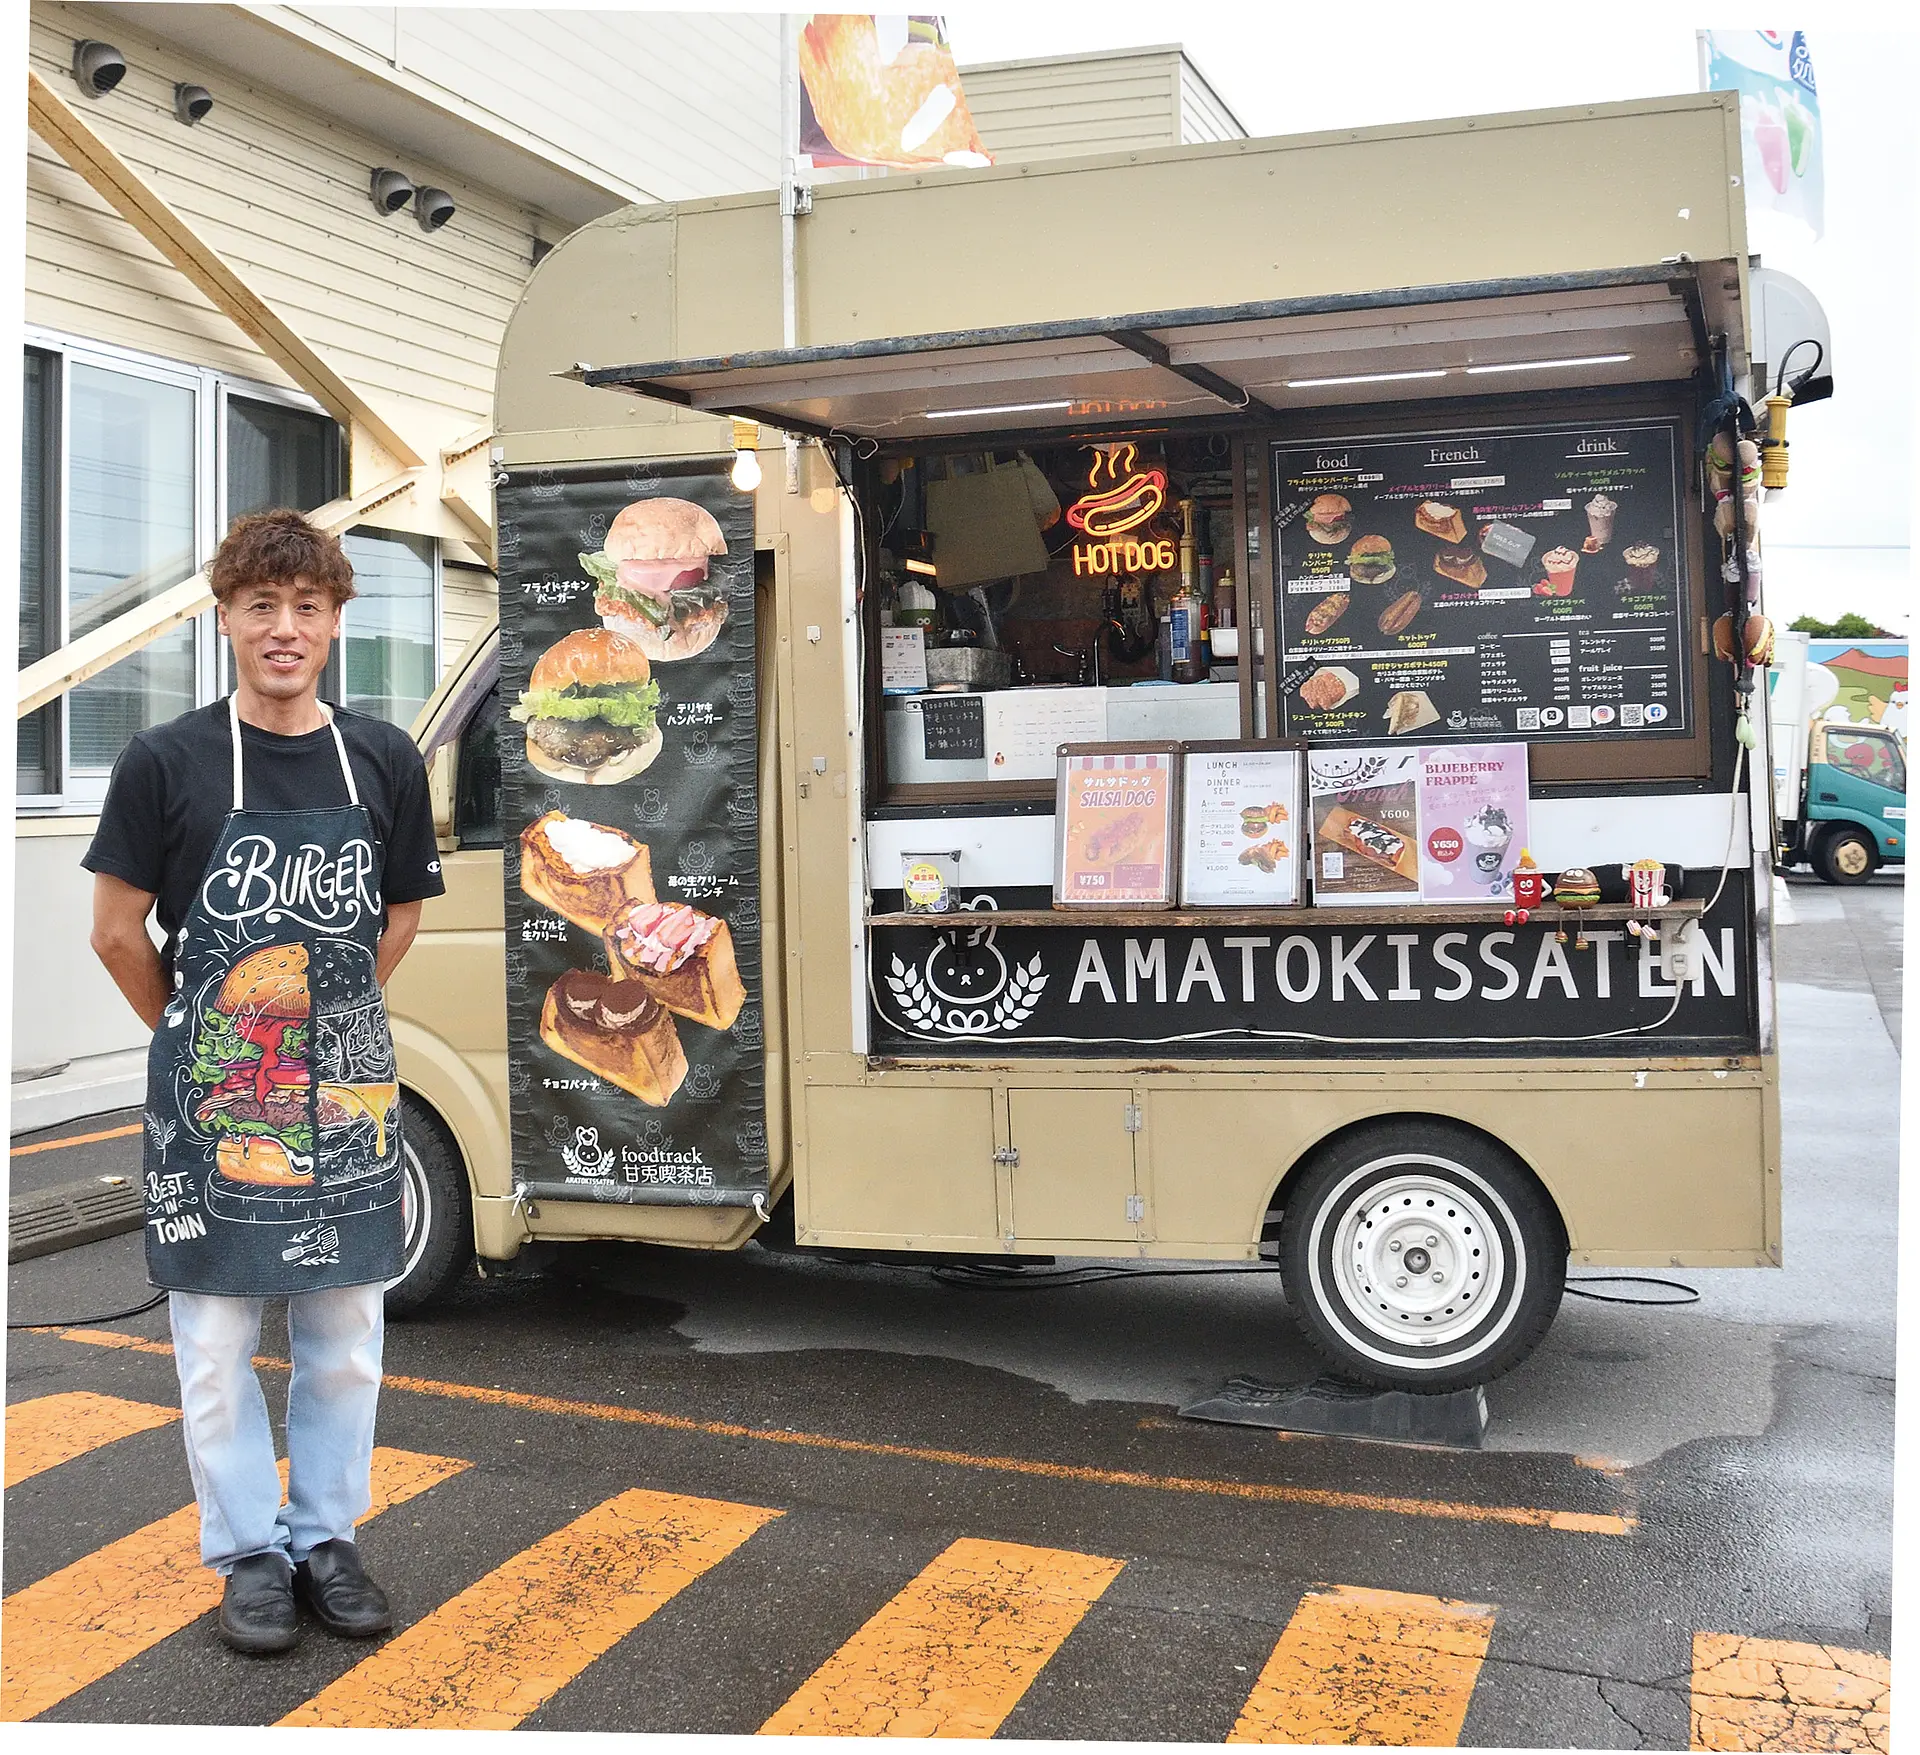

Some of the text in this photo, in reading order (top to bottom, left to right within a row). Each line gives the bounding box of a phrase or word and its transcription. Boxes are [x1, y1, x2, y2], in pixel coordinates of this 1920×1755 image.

[1577, 438, 1617, 453] drink
[1430, 446, 1479, 462] French
[1316, 454, 1349, 469] food
[1287, 476, 1355, 486] フライドチキンバーガー
[1073, 540, 1175, 576] HOT DOG
[521, 580, 591, 593] フライドチキン
[537, 592, 577, 604] バーガー
[1398, 633, 1436, 642] ホットドッグ
[1602, 664, 1623, 673] juice
[676, 702, 713, 713] テリヤキ
[667, 713, 723, 726] ハンバーガー
[1292, 711, 1367, 722] ジューシーフライドチキン
[1206, 761, 1238, 770] LUNCH
[1425, 761, 1504, 774] BLUEBERRY
[1083, 775, 1151, 787] サルサドッグ
[1207, 778, 1241, 787] DINNER
[1426, 773, 1478, 786] FRAPPÉ
[1213, 787, 1229, 795] SET
[1080, 789, 1156, 808] SALSA DOG
[1201, 799, 1207, 807] A
[1380, 809, 1410, 819] ¥600
[1200, 839, 1206, 848] B
[1432, 840, 1459, 850] ¥650
[202, 834, 382, 922] BURGER
[667, 875, 739, 888] 苺の生クリーム
[1079, 875, 1105, 886] ¥750
[683, 886, 724, 898] フレンチ
[522, 919, 566, 932] メイプルと
[522, 930, 568, 943] 生クリーム
[1069, 926, 1737, 1005] AMATOKISSATEN
[542, 1077, 601, 1091] チョコバナナ
[621, 1145, 703, 1164] foodtrack
[622, 1164, 713, 1186] 甘兎喫茶店
[147, 1171, 189, 1203] BEST
[164, 1197, 179, 1215] IN
[148, 1213, 207, 1245] TOWN
